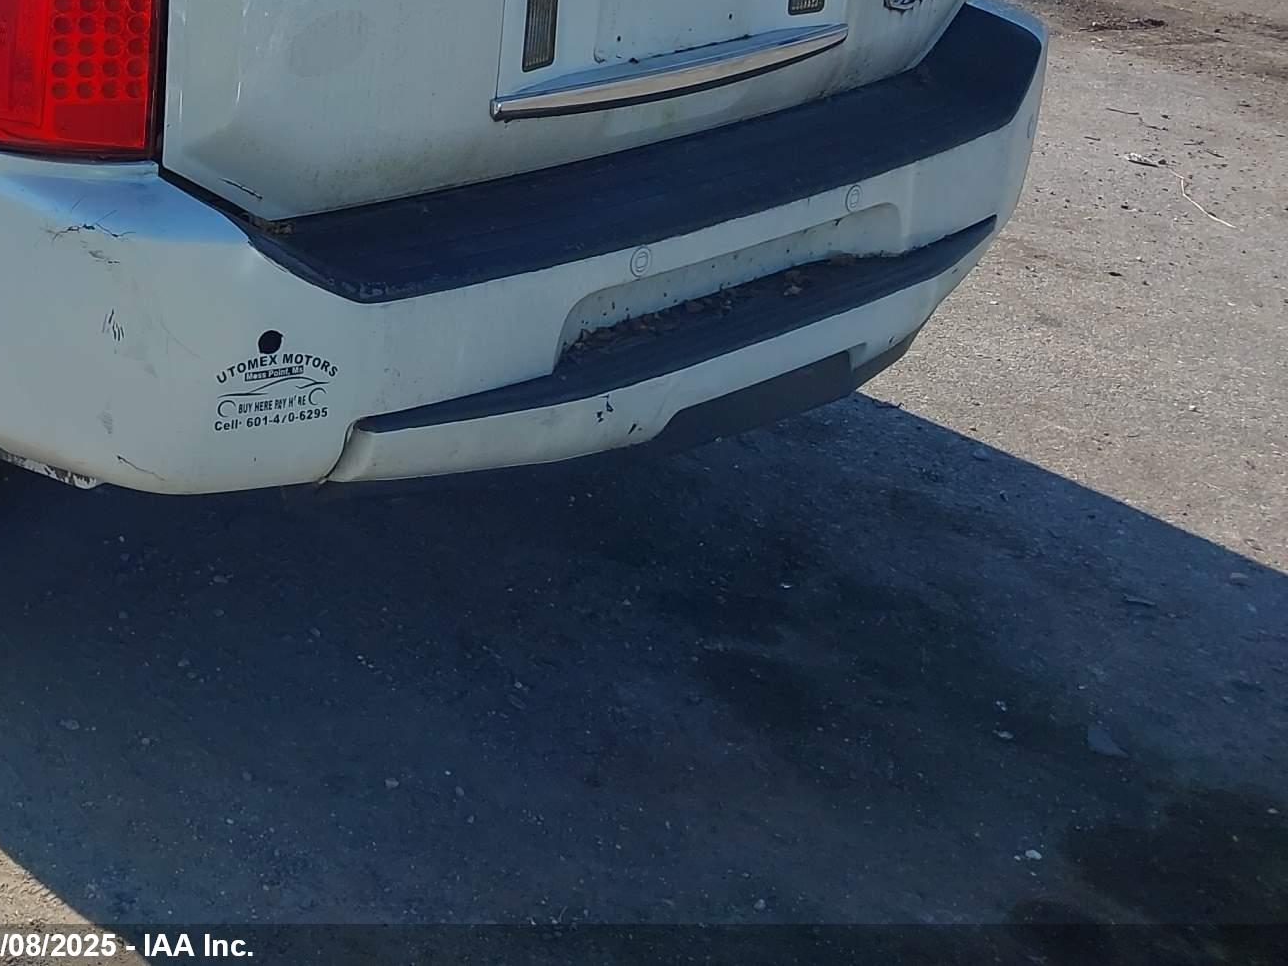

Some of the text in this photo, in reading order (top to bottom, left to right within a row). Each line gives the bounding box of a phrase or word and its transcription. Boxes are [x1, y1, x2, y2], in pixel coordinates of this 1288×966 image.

[283, 353, 339, 377] MOTORS
[238, 395, 306, 414] BUY HERE PAY HRE
